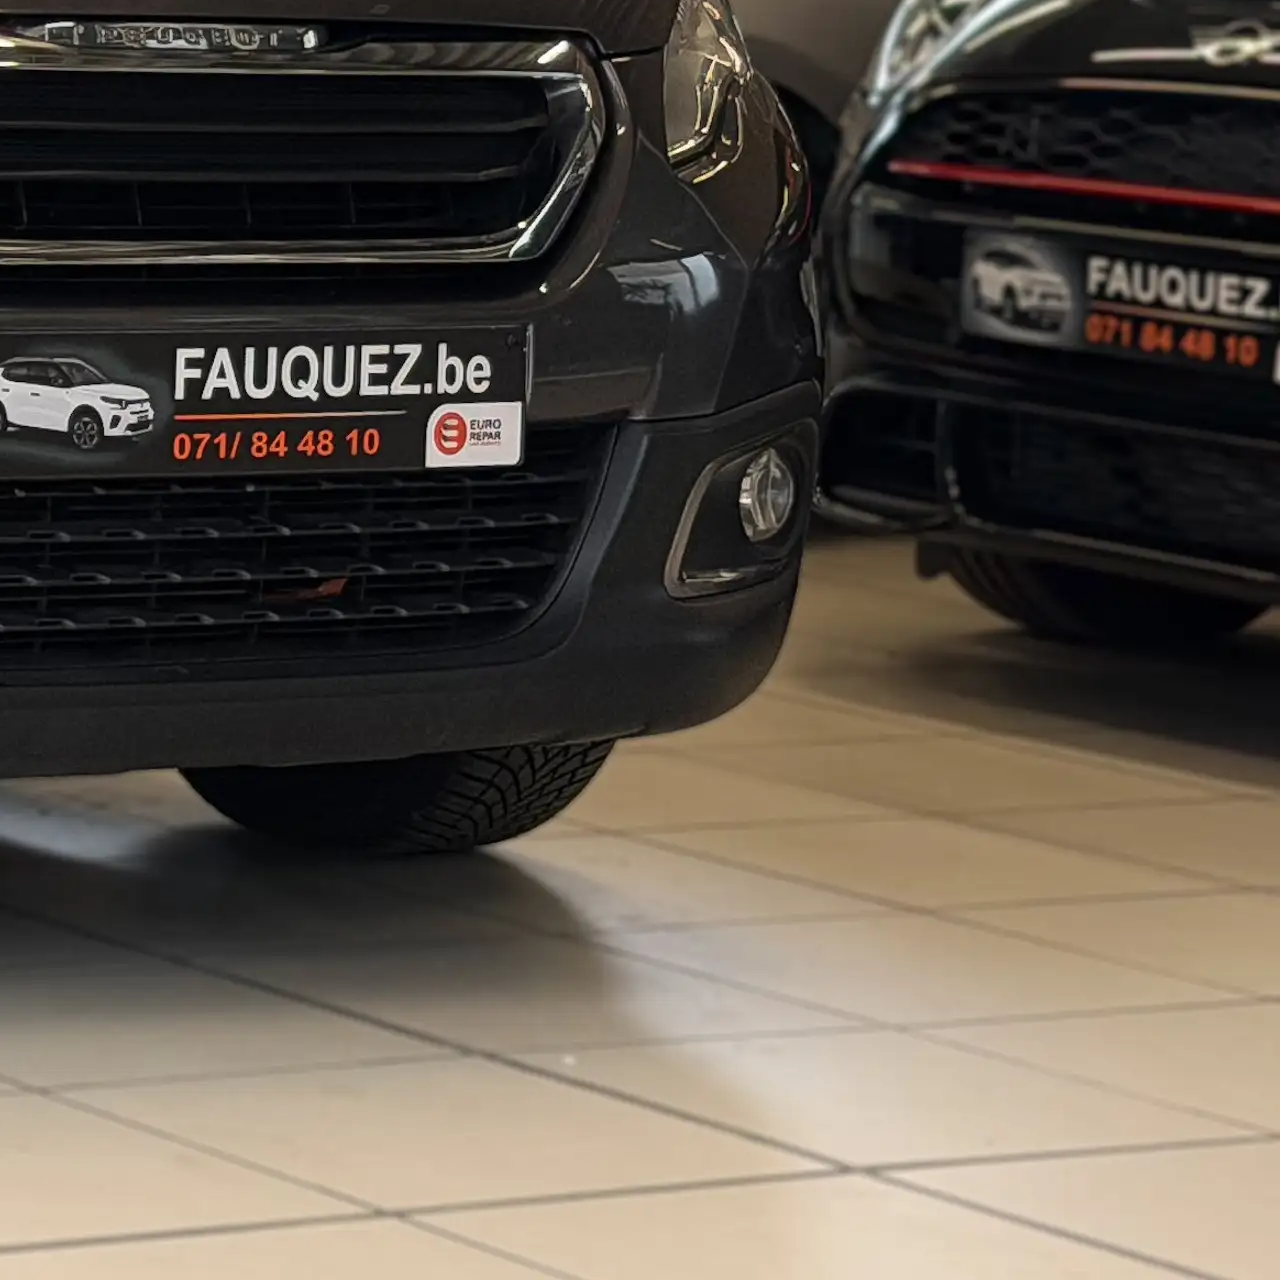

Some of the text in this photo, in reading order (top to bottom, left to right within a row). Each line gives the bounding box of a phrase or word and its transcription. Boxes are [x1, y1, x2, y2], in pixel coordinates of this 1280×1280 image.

[1225, 333, 1260, 368] 10
[174, 342, 491, 402] FAUQUEZ.be
[469, 418, 502, 430] EURO
[469, 430, 502, 441] REPAR
[173, 428, 381, 460] 071/ 84 48 10
